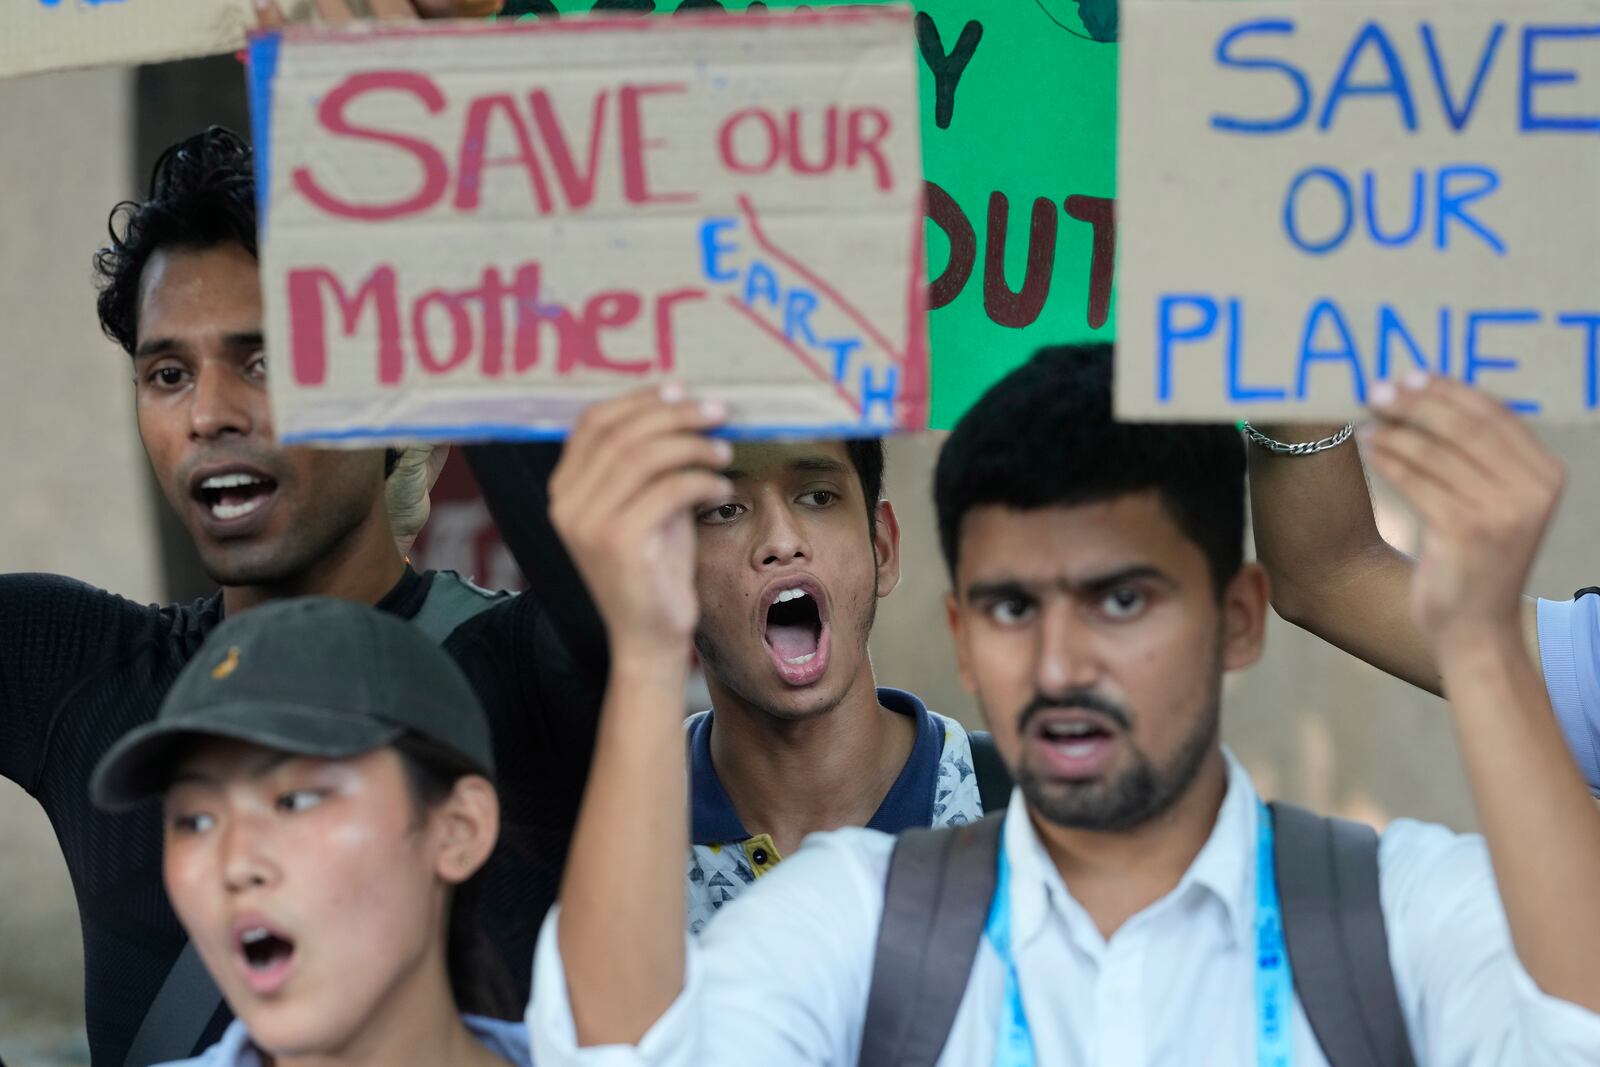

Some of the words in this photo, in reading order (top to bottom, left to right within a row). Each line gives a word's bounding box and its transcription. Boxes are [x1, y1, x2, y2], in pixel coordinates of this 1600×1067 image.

[1210, 18, 1600, 135] SAVE
[291, 70, 697, 221] SAVE
[717, 106, 893, 192] OUR
[1282, 164, 1507, 256] OUR
[287, 261, 706, 386] Mother
[698, 217, 898, 427] EARTH
[1156, 293, 1600, 414] PLANET
